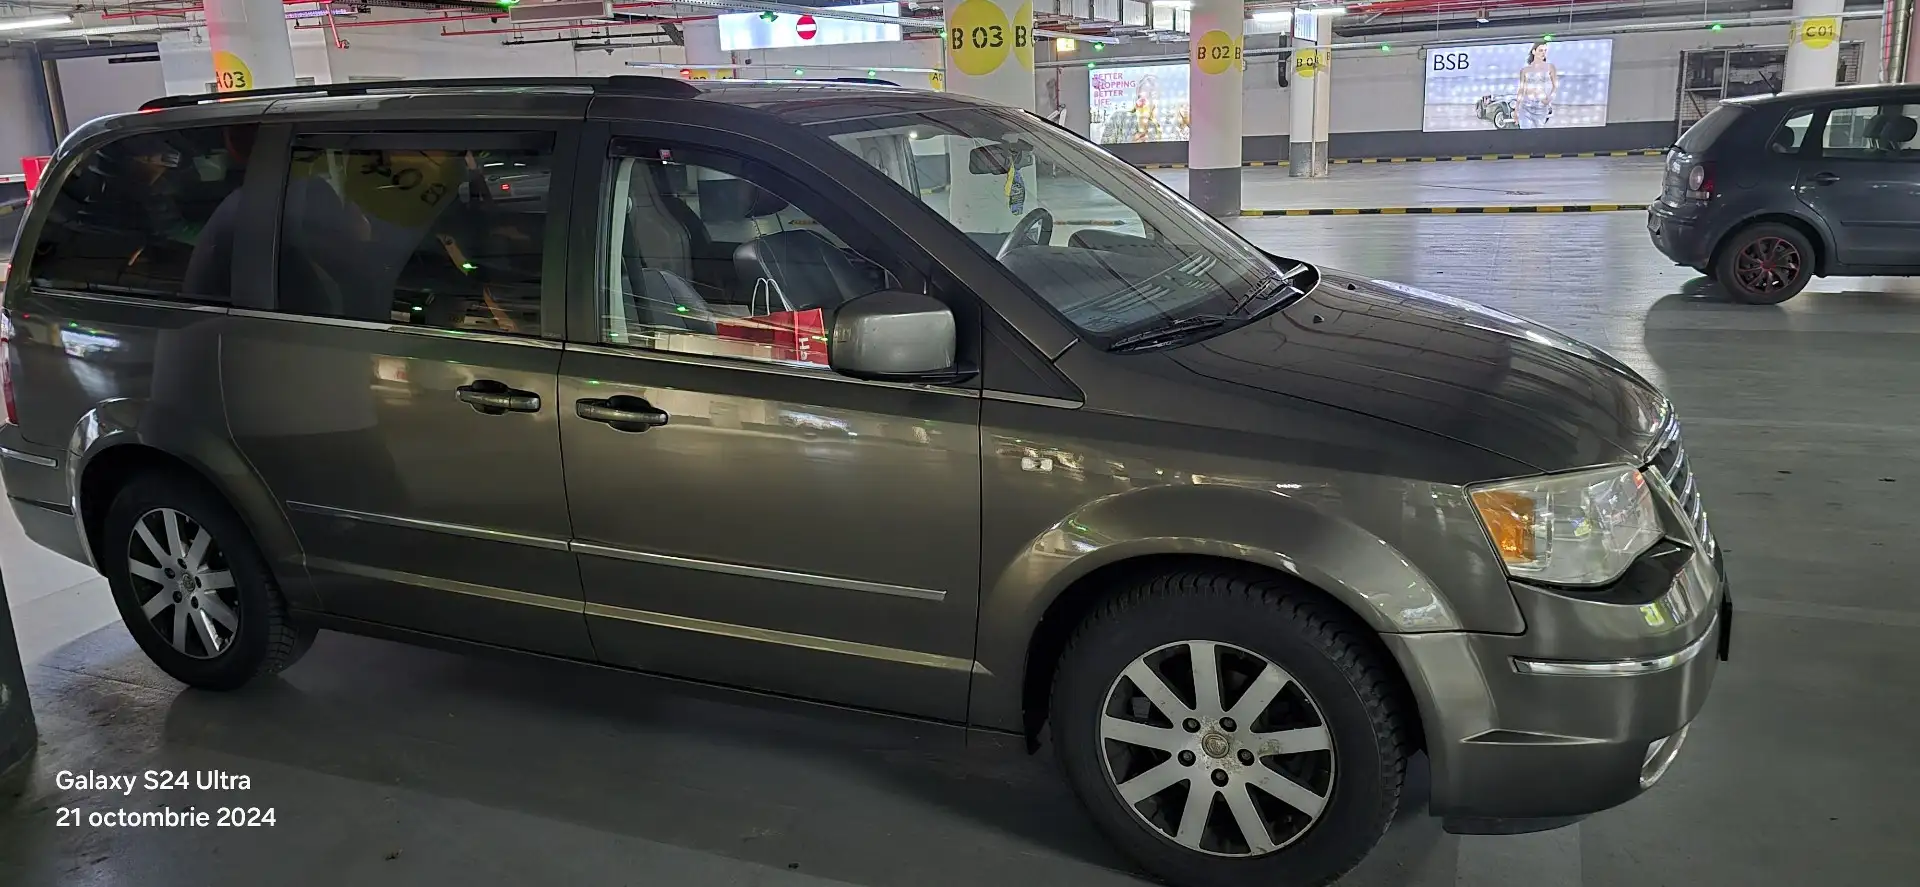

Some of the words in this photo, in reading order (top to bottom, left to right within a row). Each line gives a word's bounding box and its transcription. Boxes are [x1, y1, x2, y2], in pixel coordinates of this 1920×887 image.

[952, 28, 964, 49] B
[972, 25, 1004, 49] 03
[1198, 46, 1206, 59] B
[1211, 46, 1230, 59] 02
[1433, 53, 1469, 70] BSB
[1094, 90, 1123, 98] BETTER
